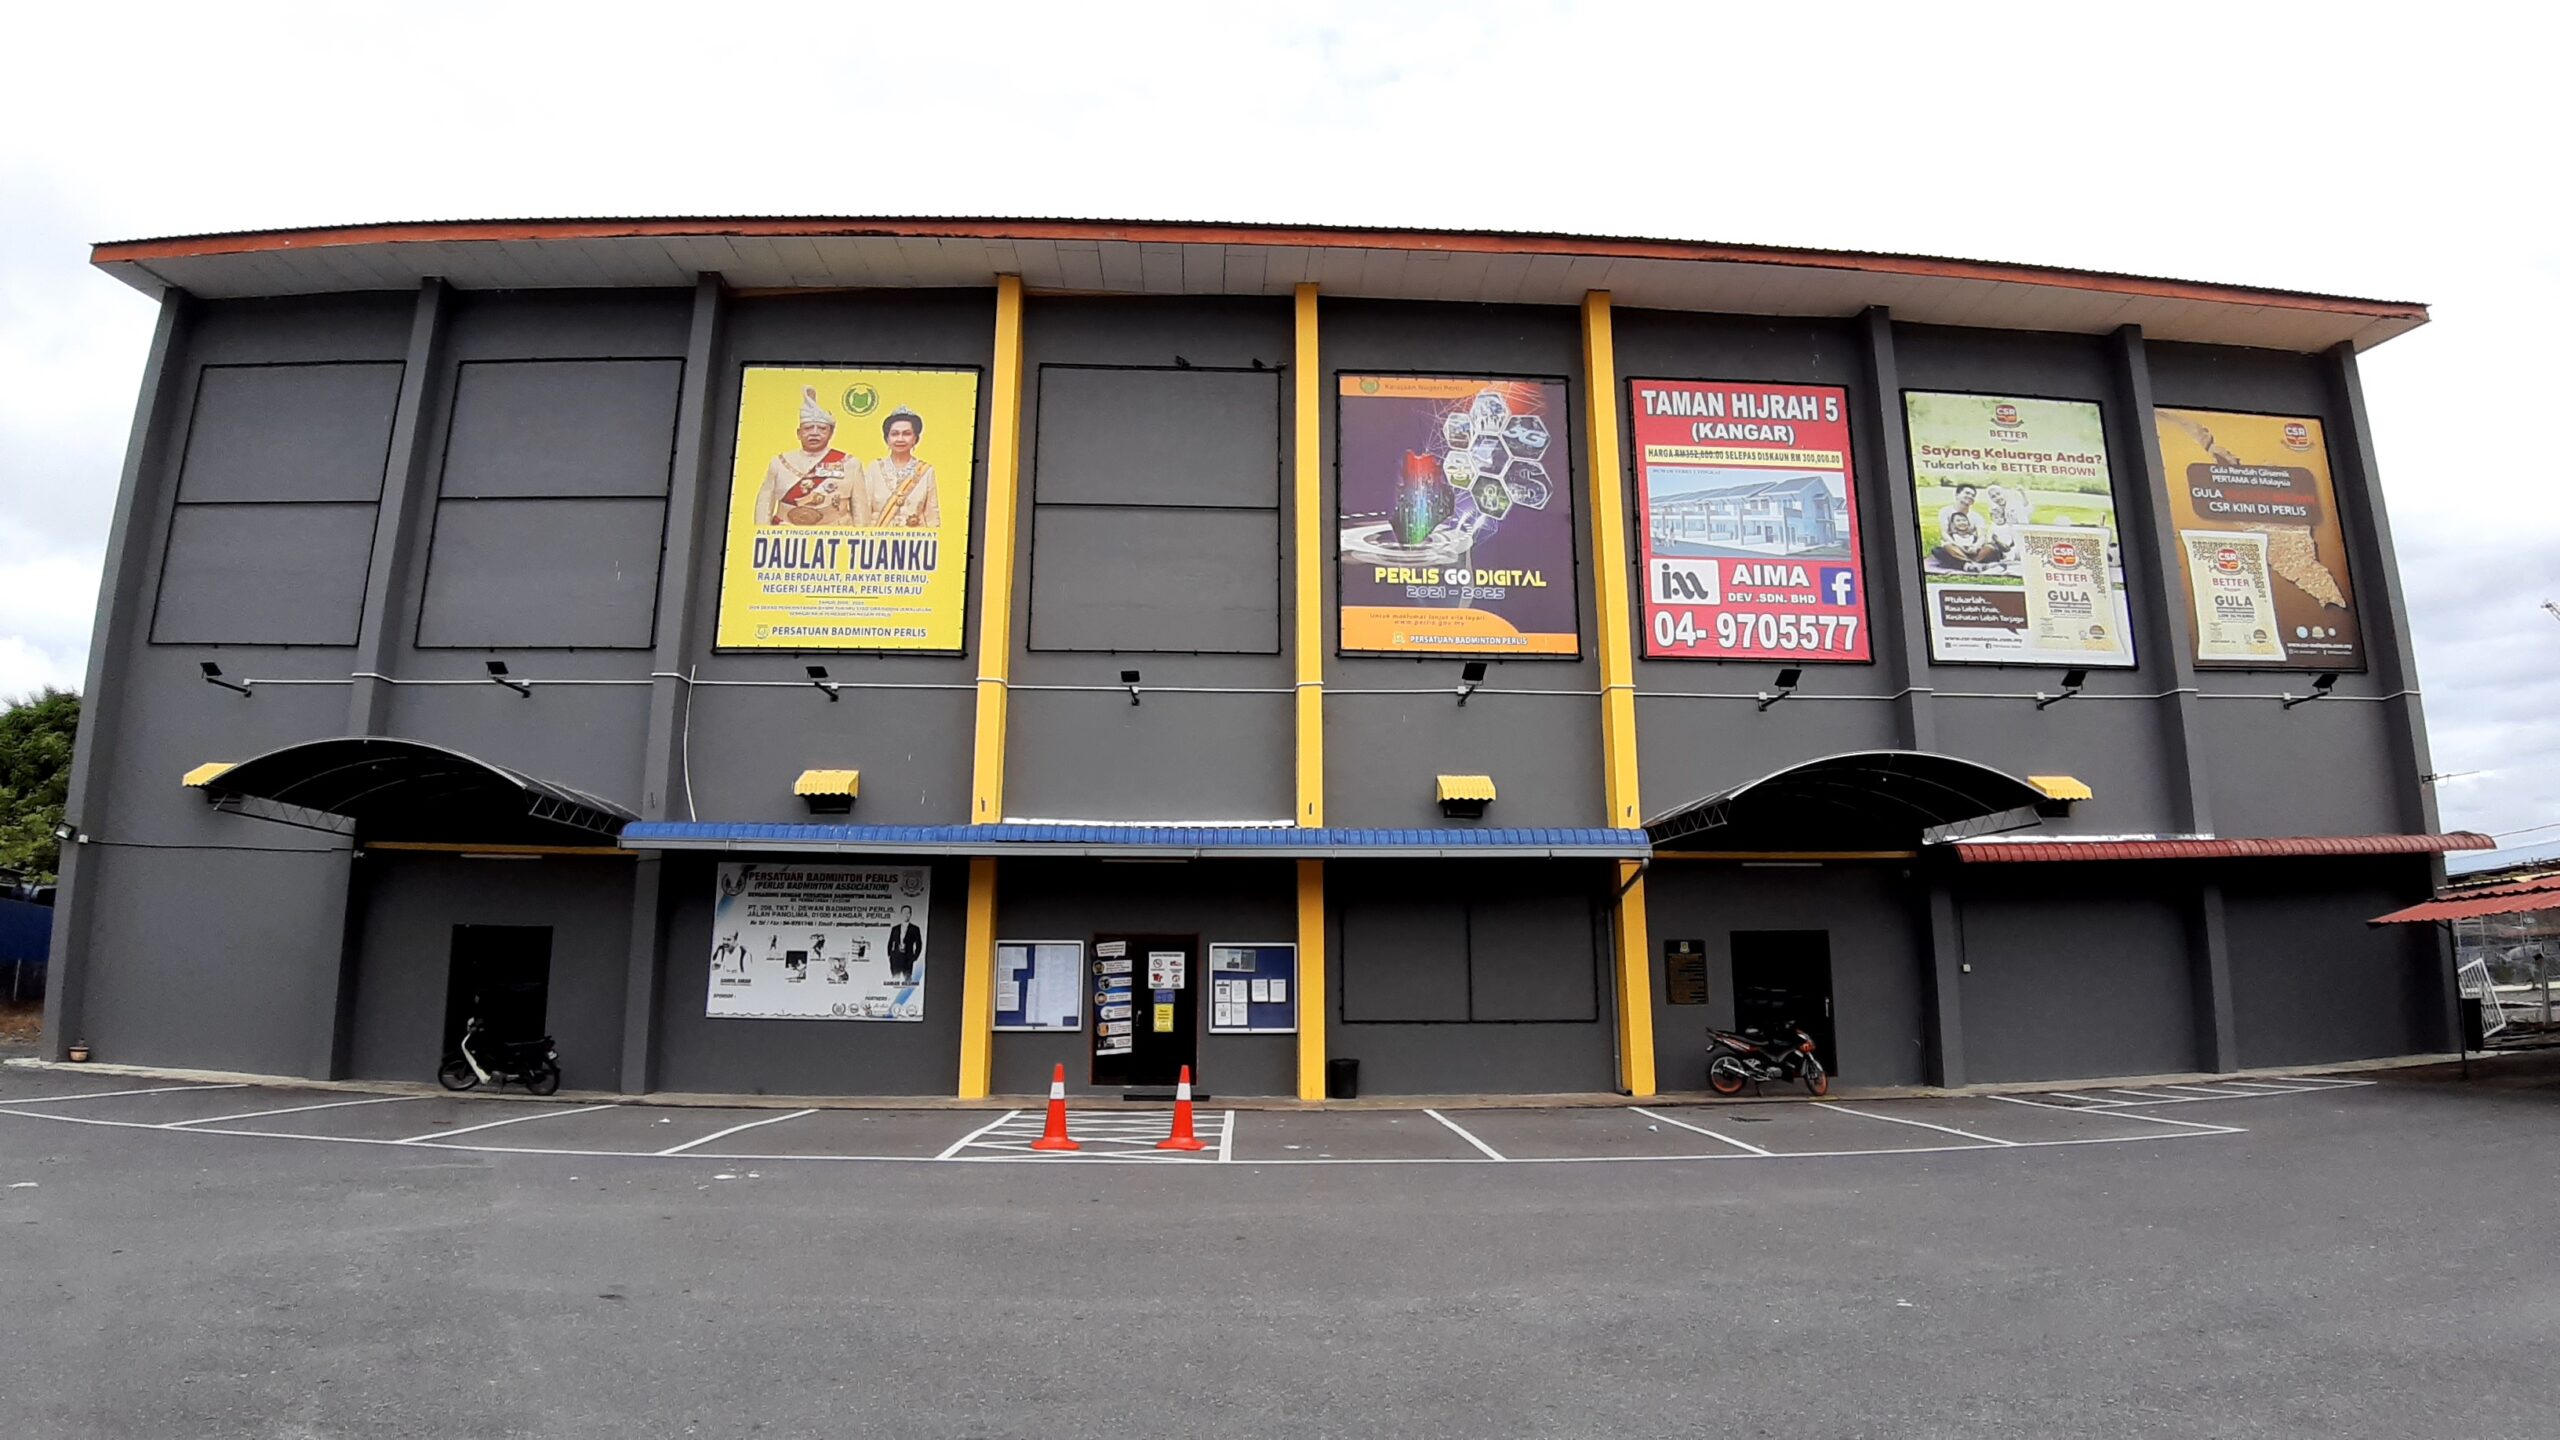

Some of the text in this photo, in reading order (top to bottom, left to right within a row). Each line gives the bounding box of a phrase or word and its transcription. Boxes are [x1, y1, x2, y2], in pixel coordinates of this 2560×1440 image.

[1641, 390, 1839, 422] TAMAN HIJRAH 5
[1996, 407, 2016, 417] CSR
[1691, 422, 1795, 445] (KANGAR)
[1989, 429, 2028, 439] BETTER
[2286, 426, 2305, 437] CSR
[1648, 449, 1673, 457] HARGA
[1725, 452, 1756, 460] SELEPAS
[1758, 453, 1789, 461] DISKAUN
[1791, 454, 1801, 462] RM
[1802, 454, 1840, 464] 300,000.00
[1921, 445, 2102, 464] Sayang Keluarga Anda?
[1922, 459, 2096, 477] Tukarlah ke BETTER BROWN
[2209, 466, 2228, 474] Gula
[2229, 467, 2258, 475] Rendah
[2211, 475, 2291, 488] PERTAMA di Malaysia
[2192, 487, 2223, 498] GULA
[2209, 502, 2307, 516] CSR KINI DI PERLIS
[753, 537, 938, 571] DAULAT TUANKU
[2053, 547, 2075, 556] CSR
[2218, 553, 2237, 561] CSR
[757, 572, 929, 584] RAJA BERDAULAT, RAKYAT BERILMU,
[1375, 567, 1547, 587] PERLIS GO DIGITAL
[1731, 564, 1810, 588] AIMA
[2045, 572, 2088, 582] BETTER
[2212, 578, 2249, 587] BETTER
[763, 584, 922, 595] NEGERI SEJAHTERA, PERLIS MAJU
[1406, 586, 1446, 598] 2021
[1462, 587, 1505, 599] 2025
[1728, 592, 1752, 603] DEV
[1791, 594, 1816, 604] BHD
[2047, 590, 2091, 602] GULA
[2214, 595, 2253, 607] GULA
[772, 626, 926, 637] PERSATUAN BADMINTON PERLIS
[1654, 611, 1858, 651] 04- 9705577
[1410, 635, 1528, 645] PERSATUAN BADMINTON PERLIS
[748, 872, 898, 883] PERSATUAN BADMINTON PERLIS
[754, 882, 785, 890] (PERLIS
[835, 883, 889, 892] ASSOCIATION)
